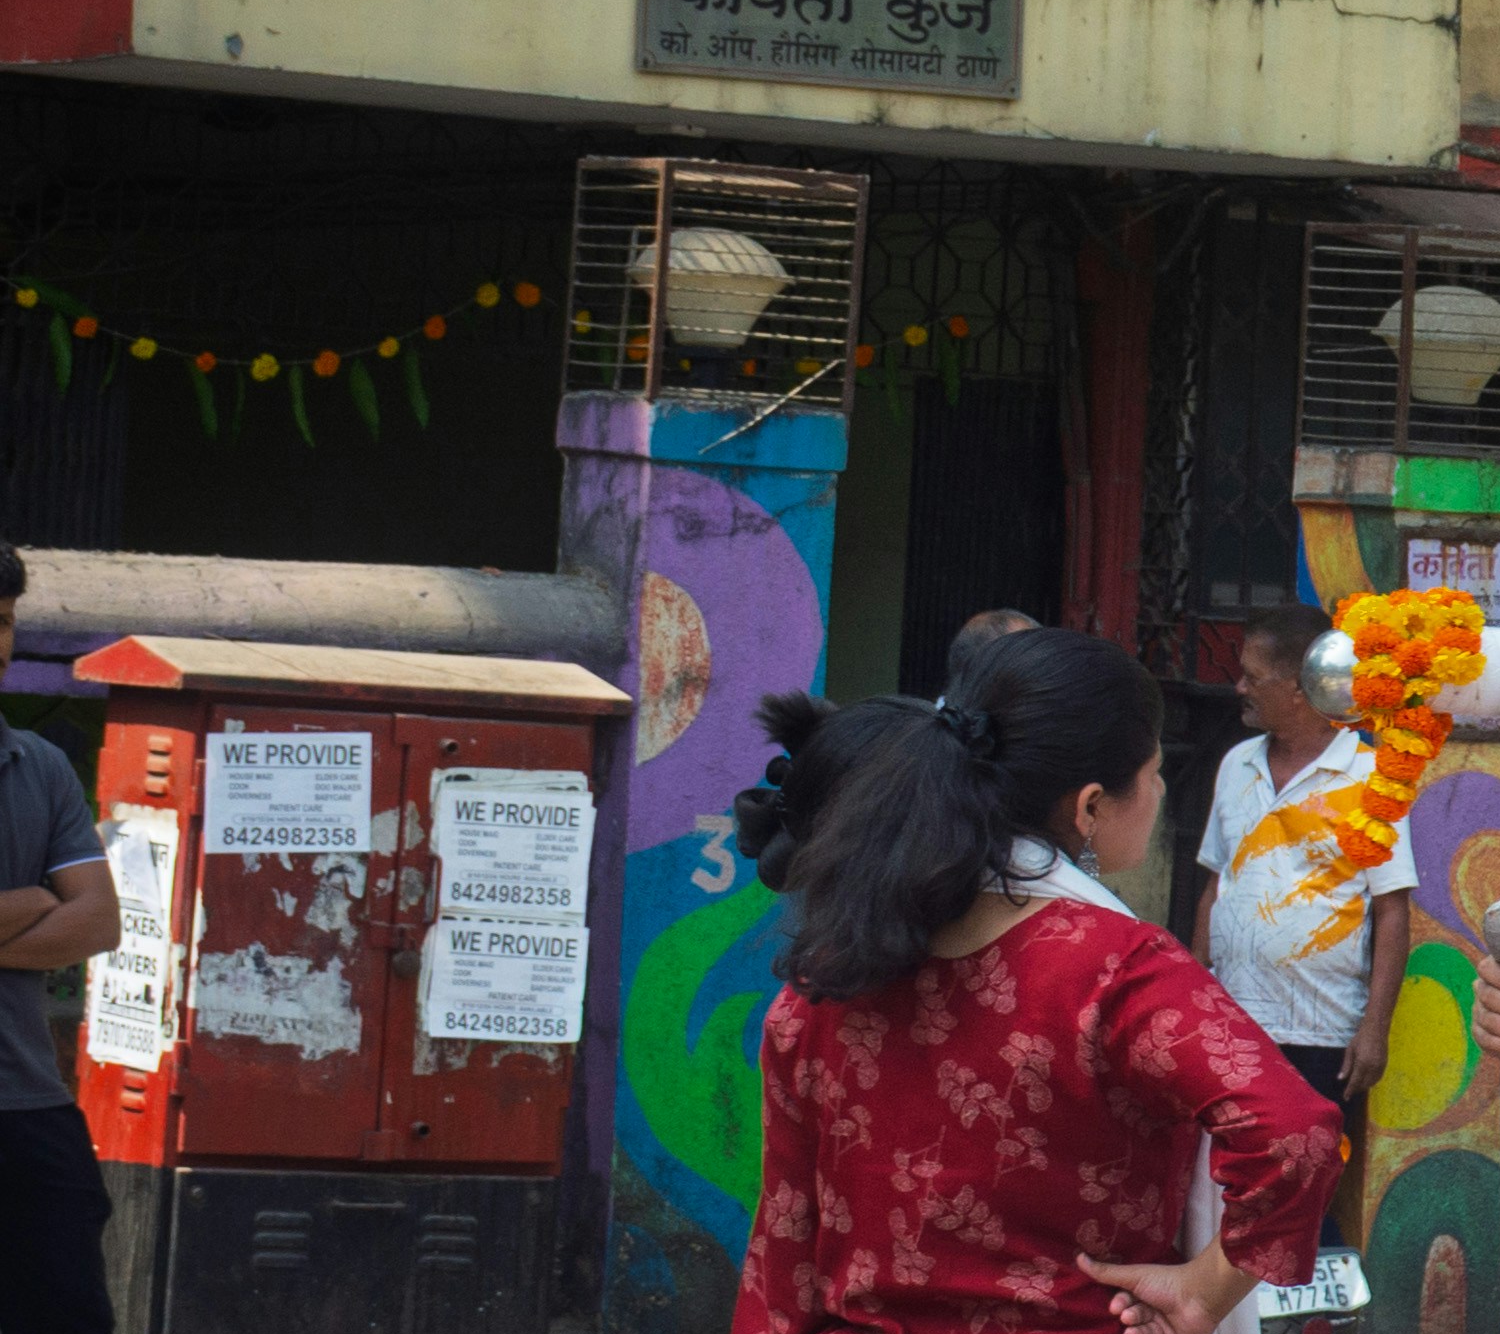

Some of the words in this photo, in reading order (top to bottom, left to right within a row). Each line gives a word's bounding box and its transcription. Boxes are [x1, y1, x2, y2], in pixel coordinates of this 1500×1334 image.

[659, 23, 697, 57] को.
[771, 33, 841, 68] हौसिंग
[851, 39, 946, 77] सोसायटी
[956, 47, 1000, 81] ठाणे
[223, 744, 257, 764] WE
[266, 745, 362, 765] PROVIDE
[456, 800, 487, 821] WE
[493, 803, 580, 827] PROVIDE
[223, 826, 356, 846] 8424982358
[691, 815, 736, 893] 3
[451, 882, 571, 906] 8424982358
[123, 912, 163, 940] CKERS
[451, 930, 482, 951] WE
[488, 933, 578, 958] PROVIDE
[446, 1012, 567, 1037] 8424982358
